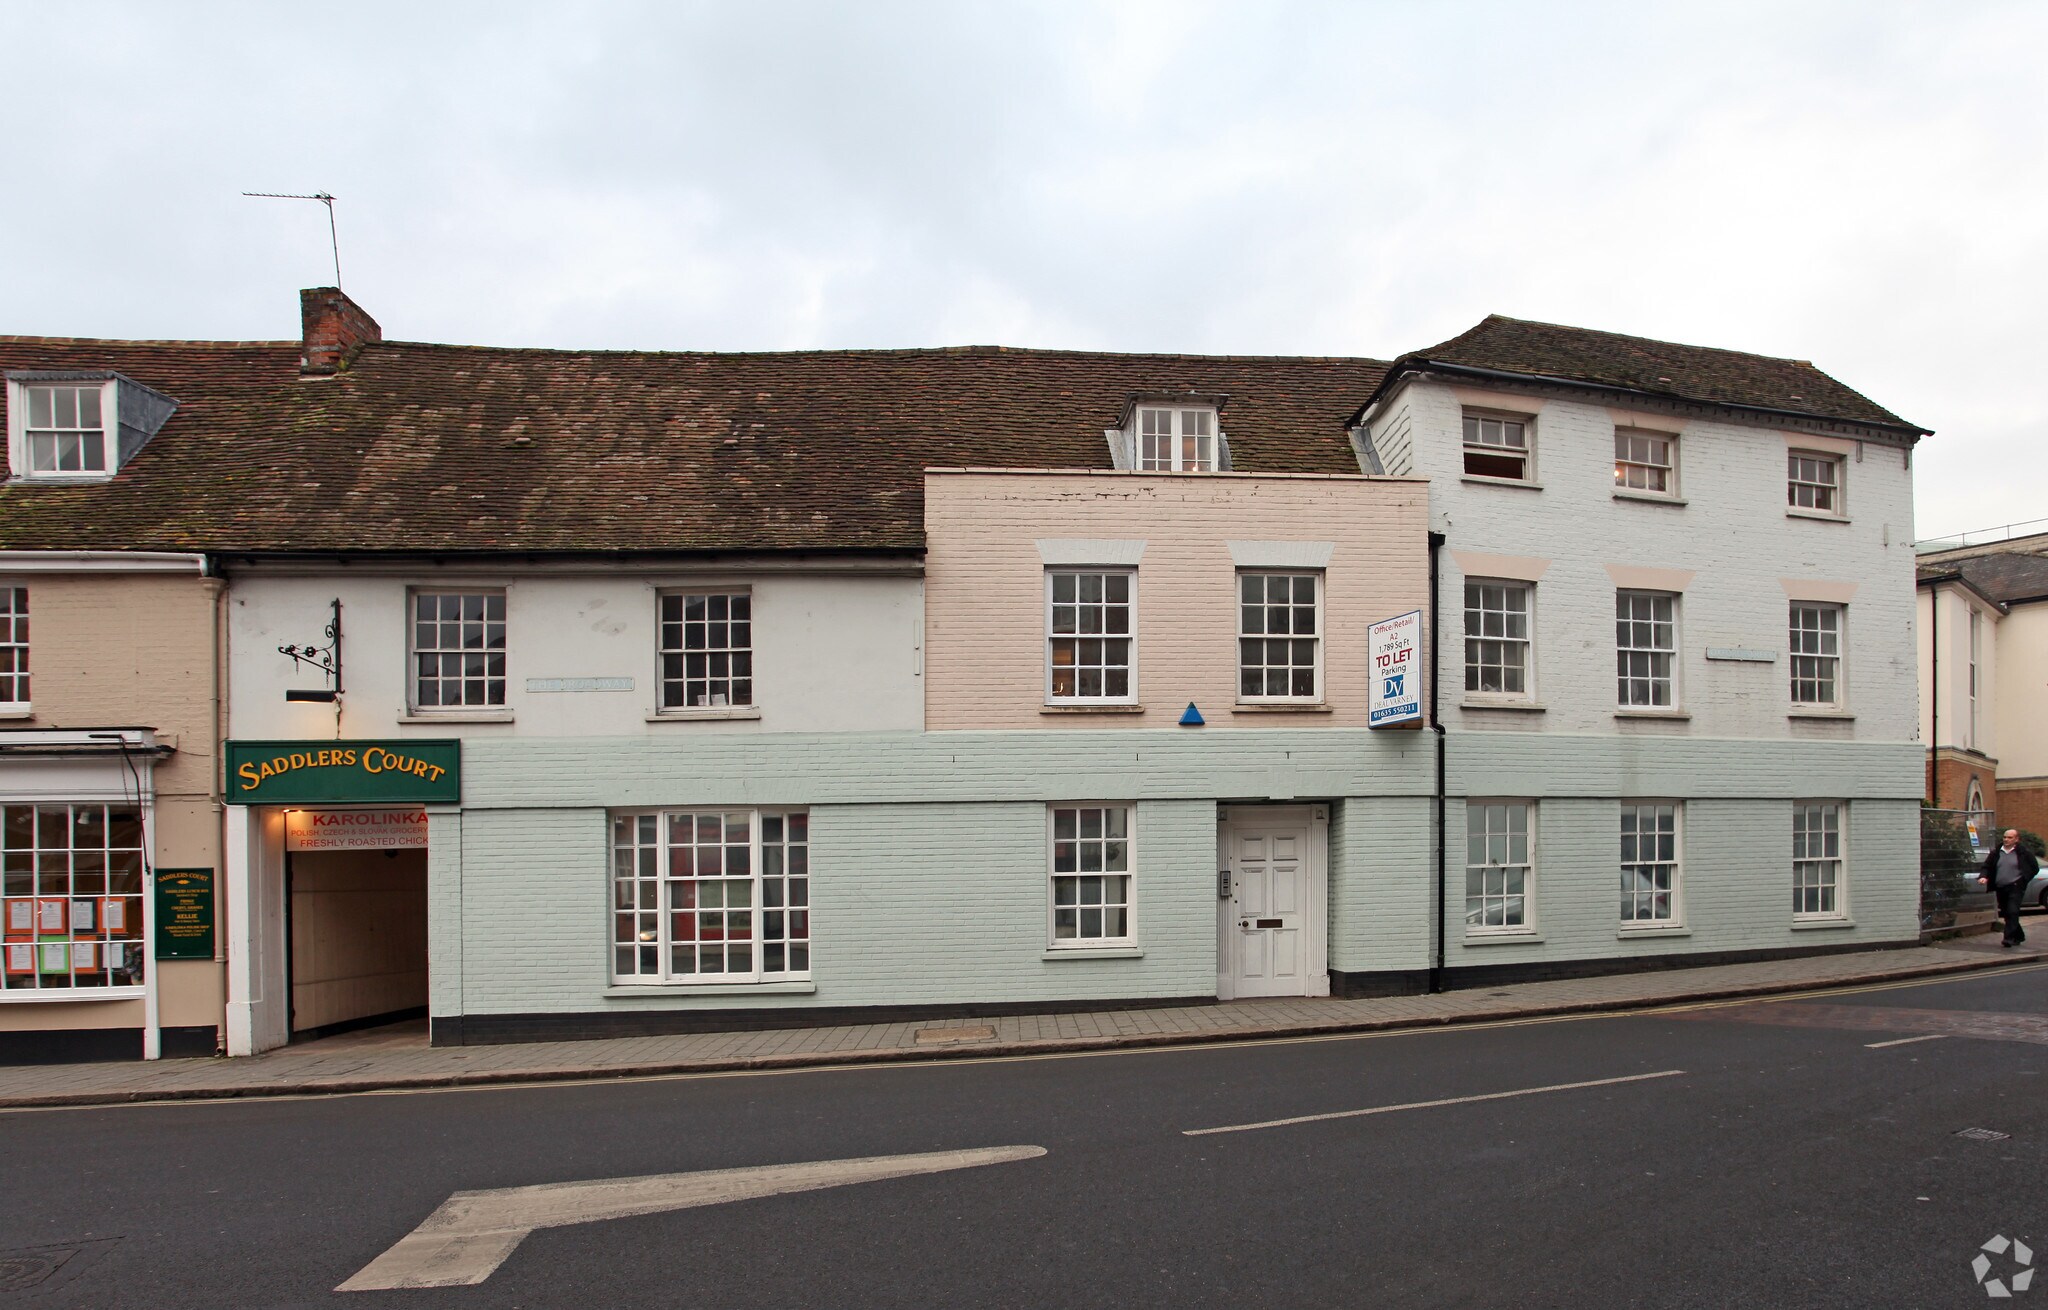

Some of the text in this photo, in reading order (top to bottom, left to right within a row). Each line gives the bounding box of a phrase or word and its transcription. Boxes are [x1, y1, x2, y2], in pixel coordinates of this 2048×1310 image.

[1389, 633, 1398, 641] A2
[1379, 638, 1410, 653] 1,789 Sq Ft
[1376, 648, 1413, 668] TO LET
[1381, 664, 1407, 677] Parking
[1373, 708, 1392, 719] 01635
[1392, 704, 1415, 715] 550211
[238, 747, 446, 791] SADDLERS COURT
[313, 812, 428, 826] KAROLINKA
[390, 826, 428, 834] GROCERY
[300, 839, 345, 847] FRESHLY
[348, 837, 396, 846] ROASTED
